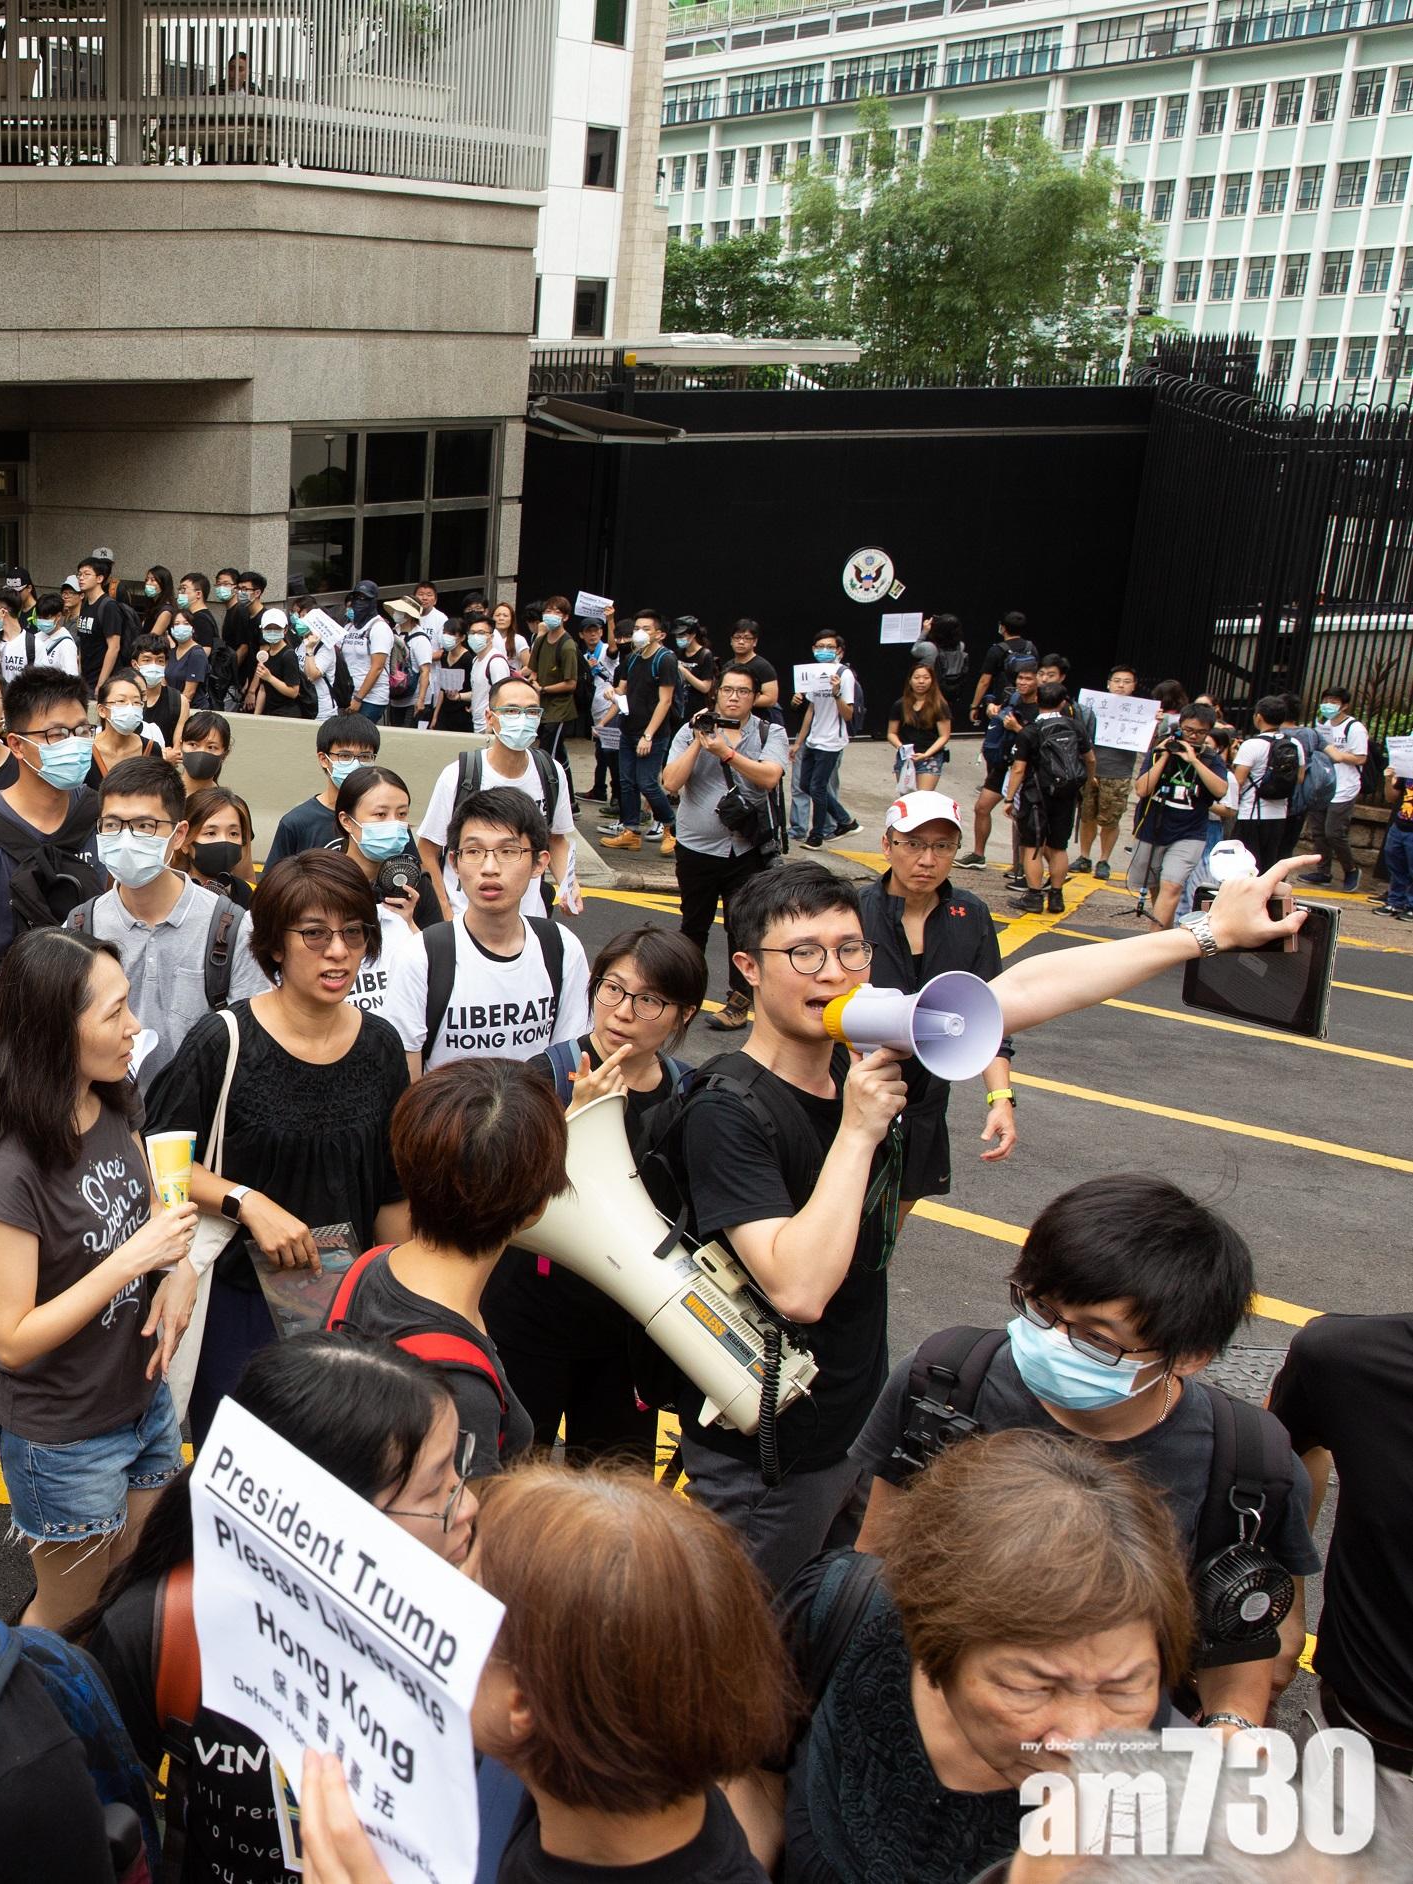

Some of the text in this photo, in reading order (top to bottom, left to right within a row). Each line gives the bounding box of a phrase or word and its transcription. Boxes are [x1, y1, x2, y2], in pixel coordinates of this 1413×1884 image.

[445, 1032, 506, 1050] HONG
[82, 1158, 125, 1216] Once
[83, 1194, 130, 1252] upon
[128, 1178, 142, 1199] a
[685, 1295, 754, 1360] WIRELESS MEGAPHONE
[210, 1445, 458, 1670] President Trump
[213, 1515, 446, 1734] Please Liberate
[233, 1674, 283, 1725] Defend
[254, 1602, 415, 1784] Hong Kong
